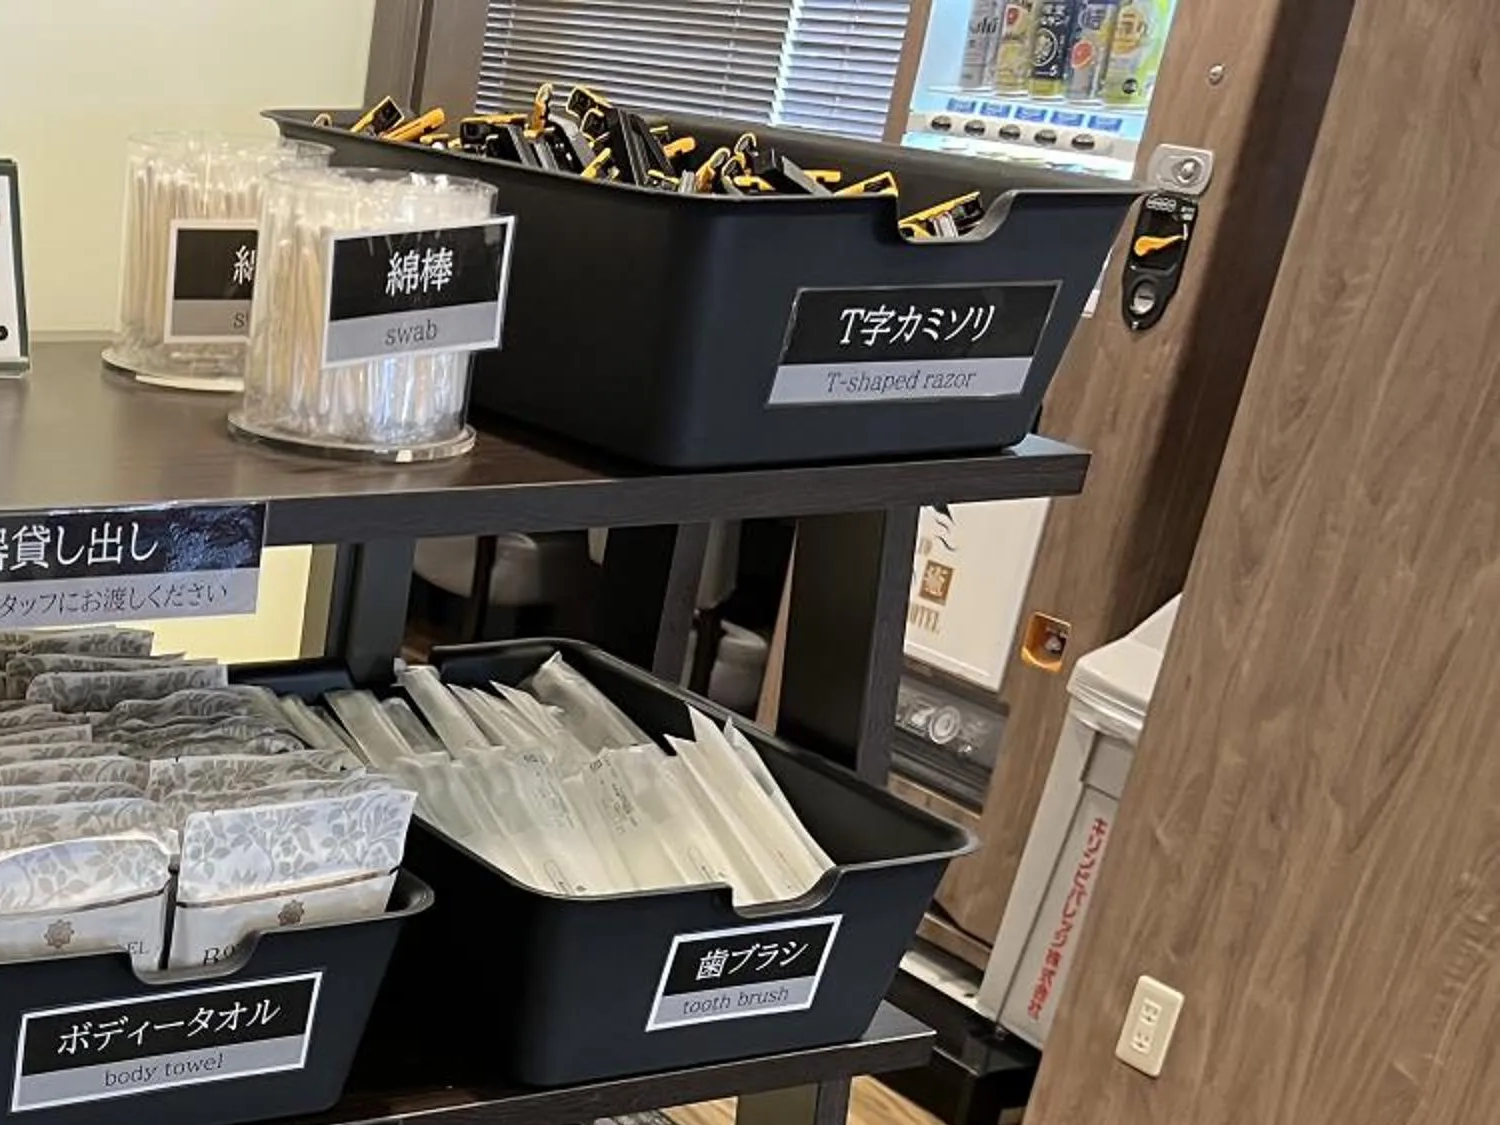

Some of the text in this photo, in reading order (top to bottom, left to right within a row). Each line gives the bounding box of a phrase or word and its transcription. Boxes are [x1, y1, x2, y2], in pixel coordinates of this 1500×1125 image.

[385, 247, 454, 297] 綿棒
[383, 320, 439, 347] swab
[838, 304, 997, 347] T字カミソリ
[826, 367, 977, 395] T-shaped razor
[695, 941, 809, 981] 歯ブラシ
[682, 986, 790, 1015] tooth brush
[56, 999, 282, 1055] ボディータオル
[104, 1053, 224, 1087] body towel
